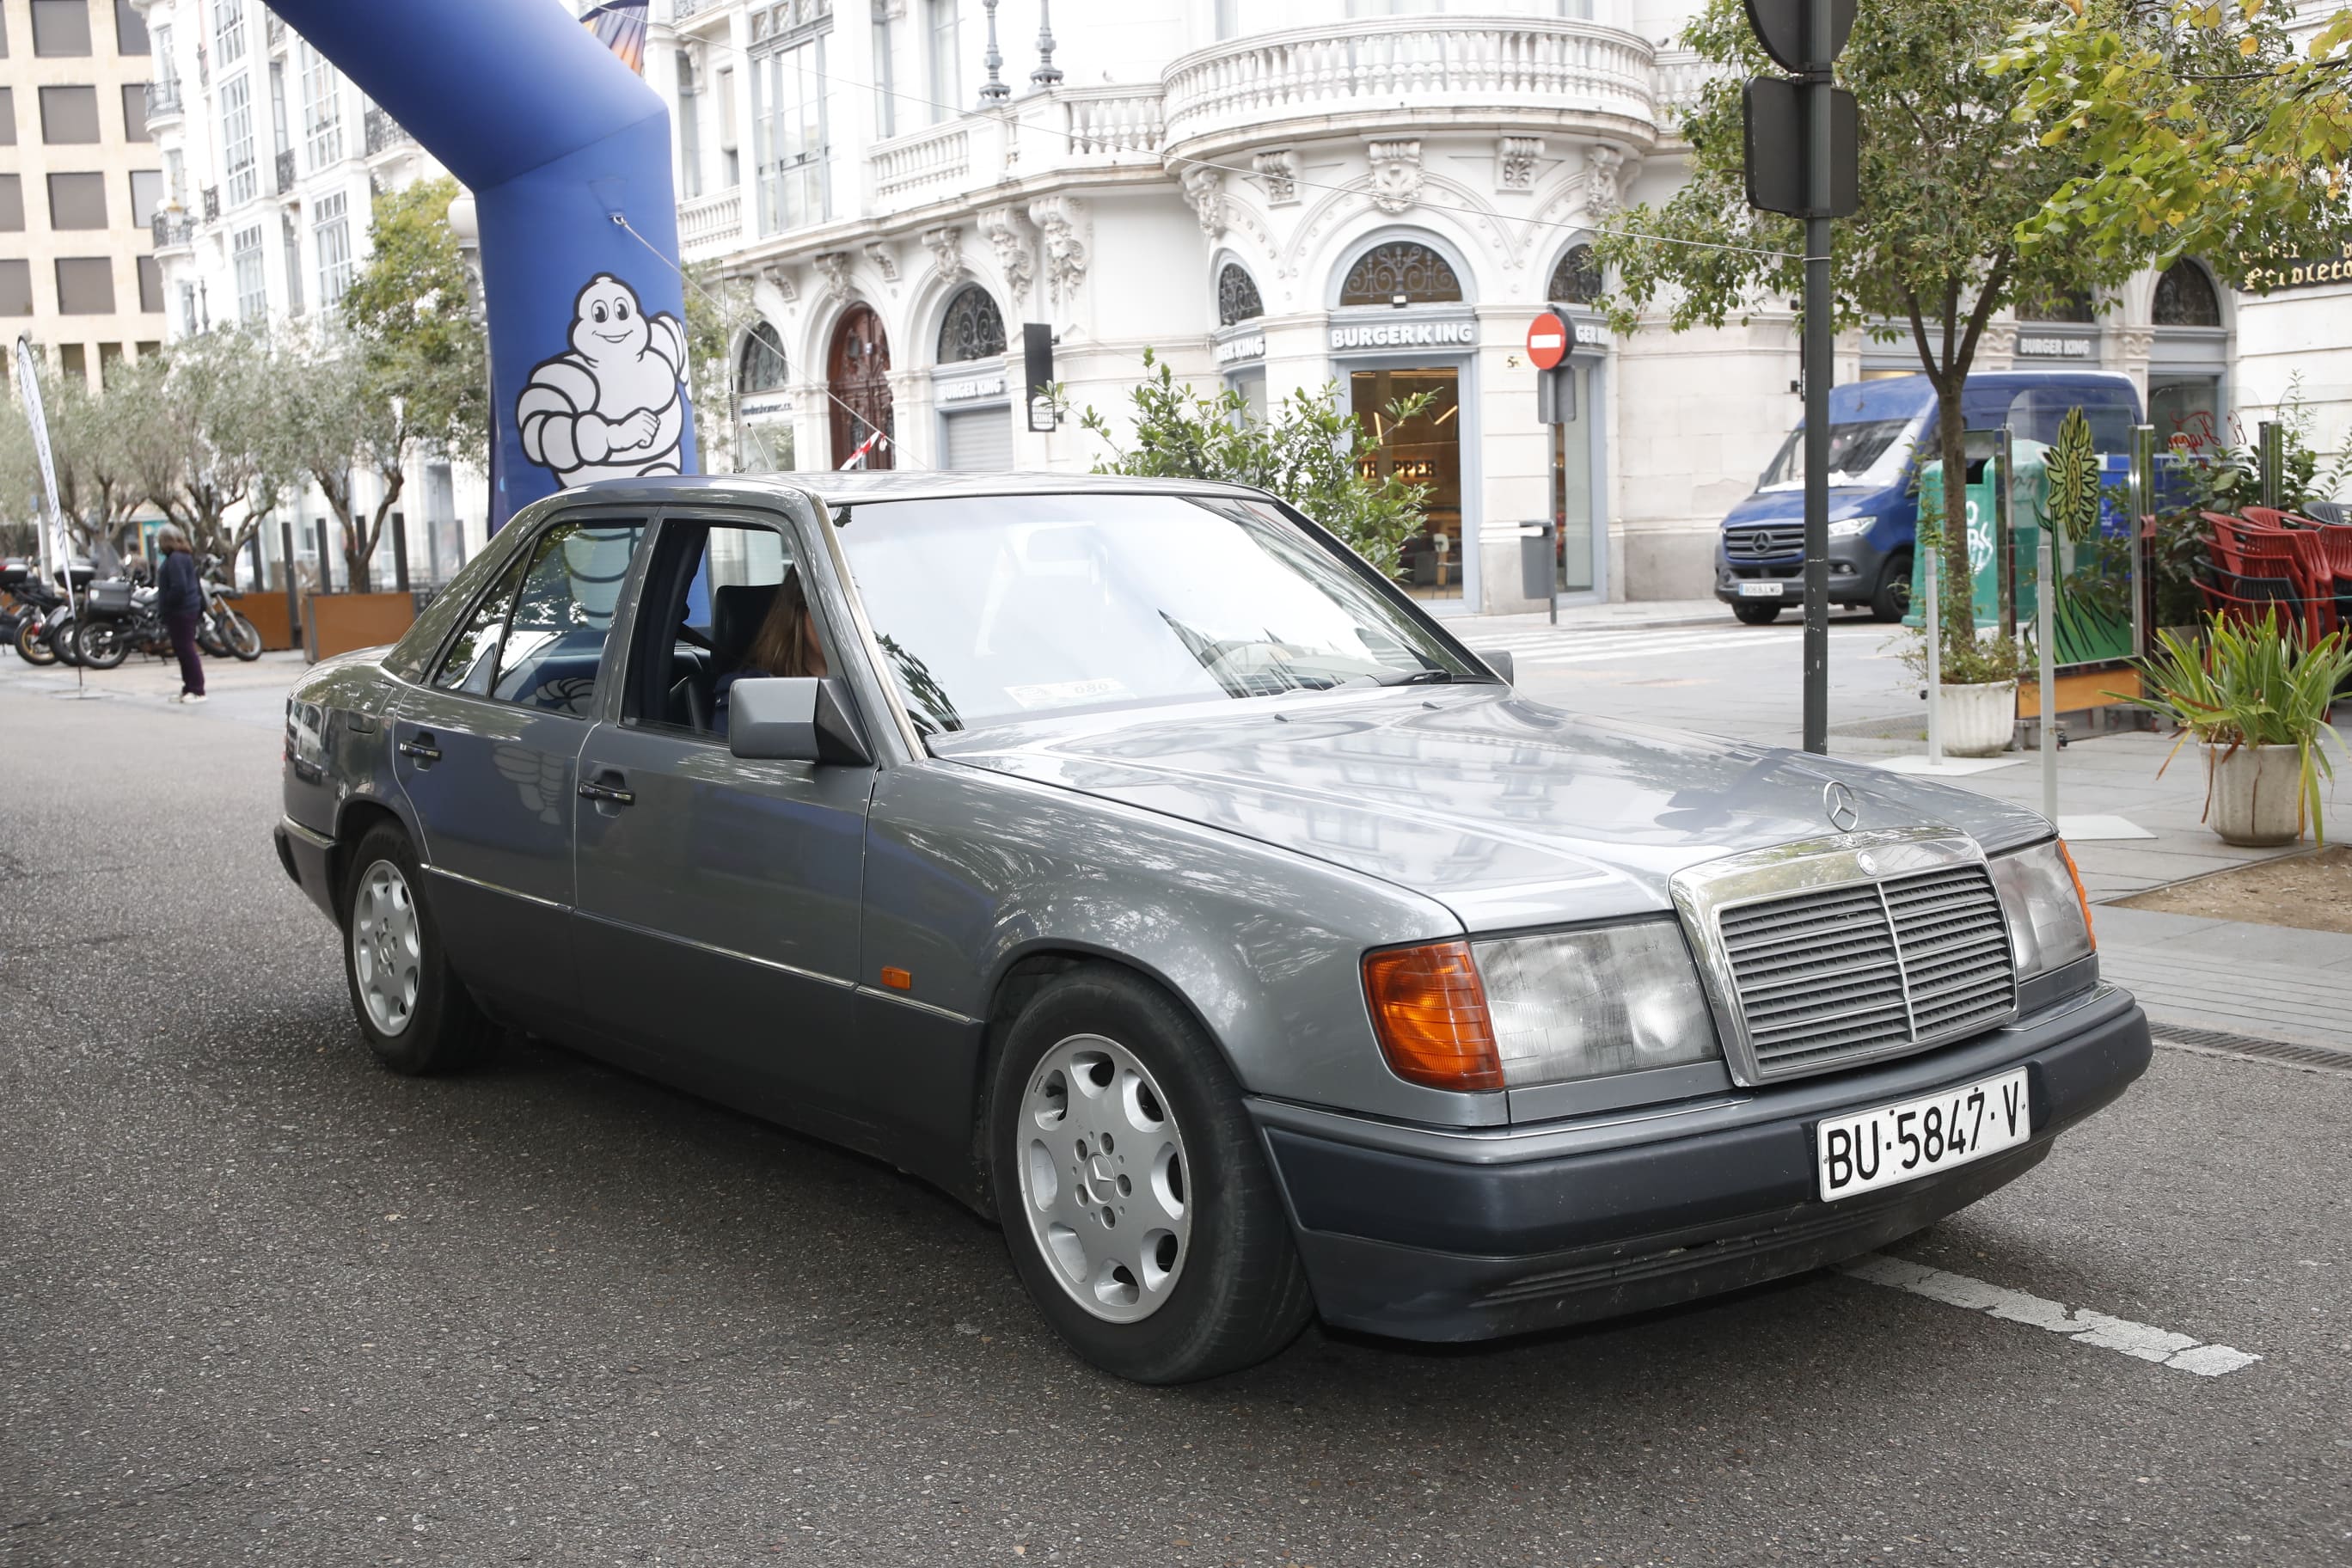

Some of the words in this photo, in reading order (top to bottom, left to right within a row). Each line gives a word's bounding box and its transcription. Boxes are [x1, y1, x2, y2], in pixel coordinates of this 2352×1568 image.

[1332, 327, 1412, 347] BURGER
[1418, 323, 1473, 343] KING
[1234, 336, 1264, 357] KING
[2020, 338, 2063, 354] BURGER
[2063, 339, 2090, 355] KING
[939, 383, 977, 401] BURGER
[977, 378, 1001, 395] KING
[1032, 413, 1053, 423] KING
